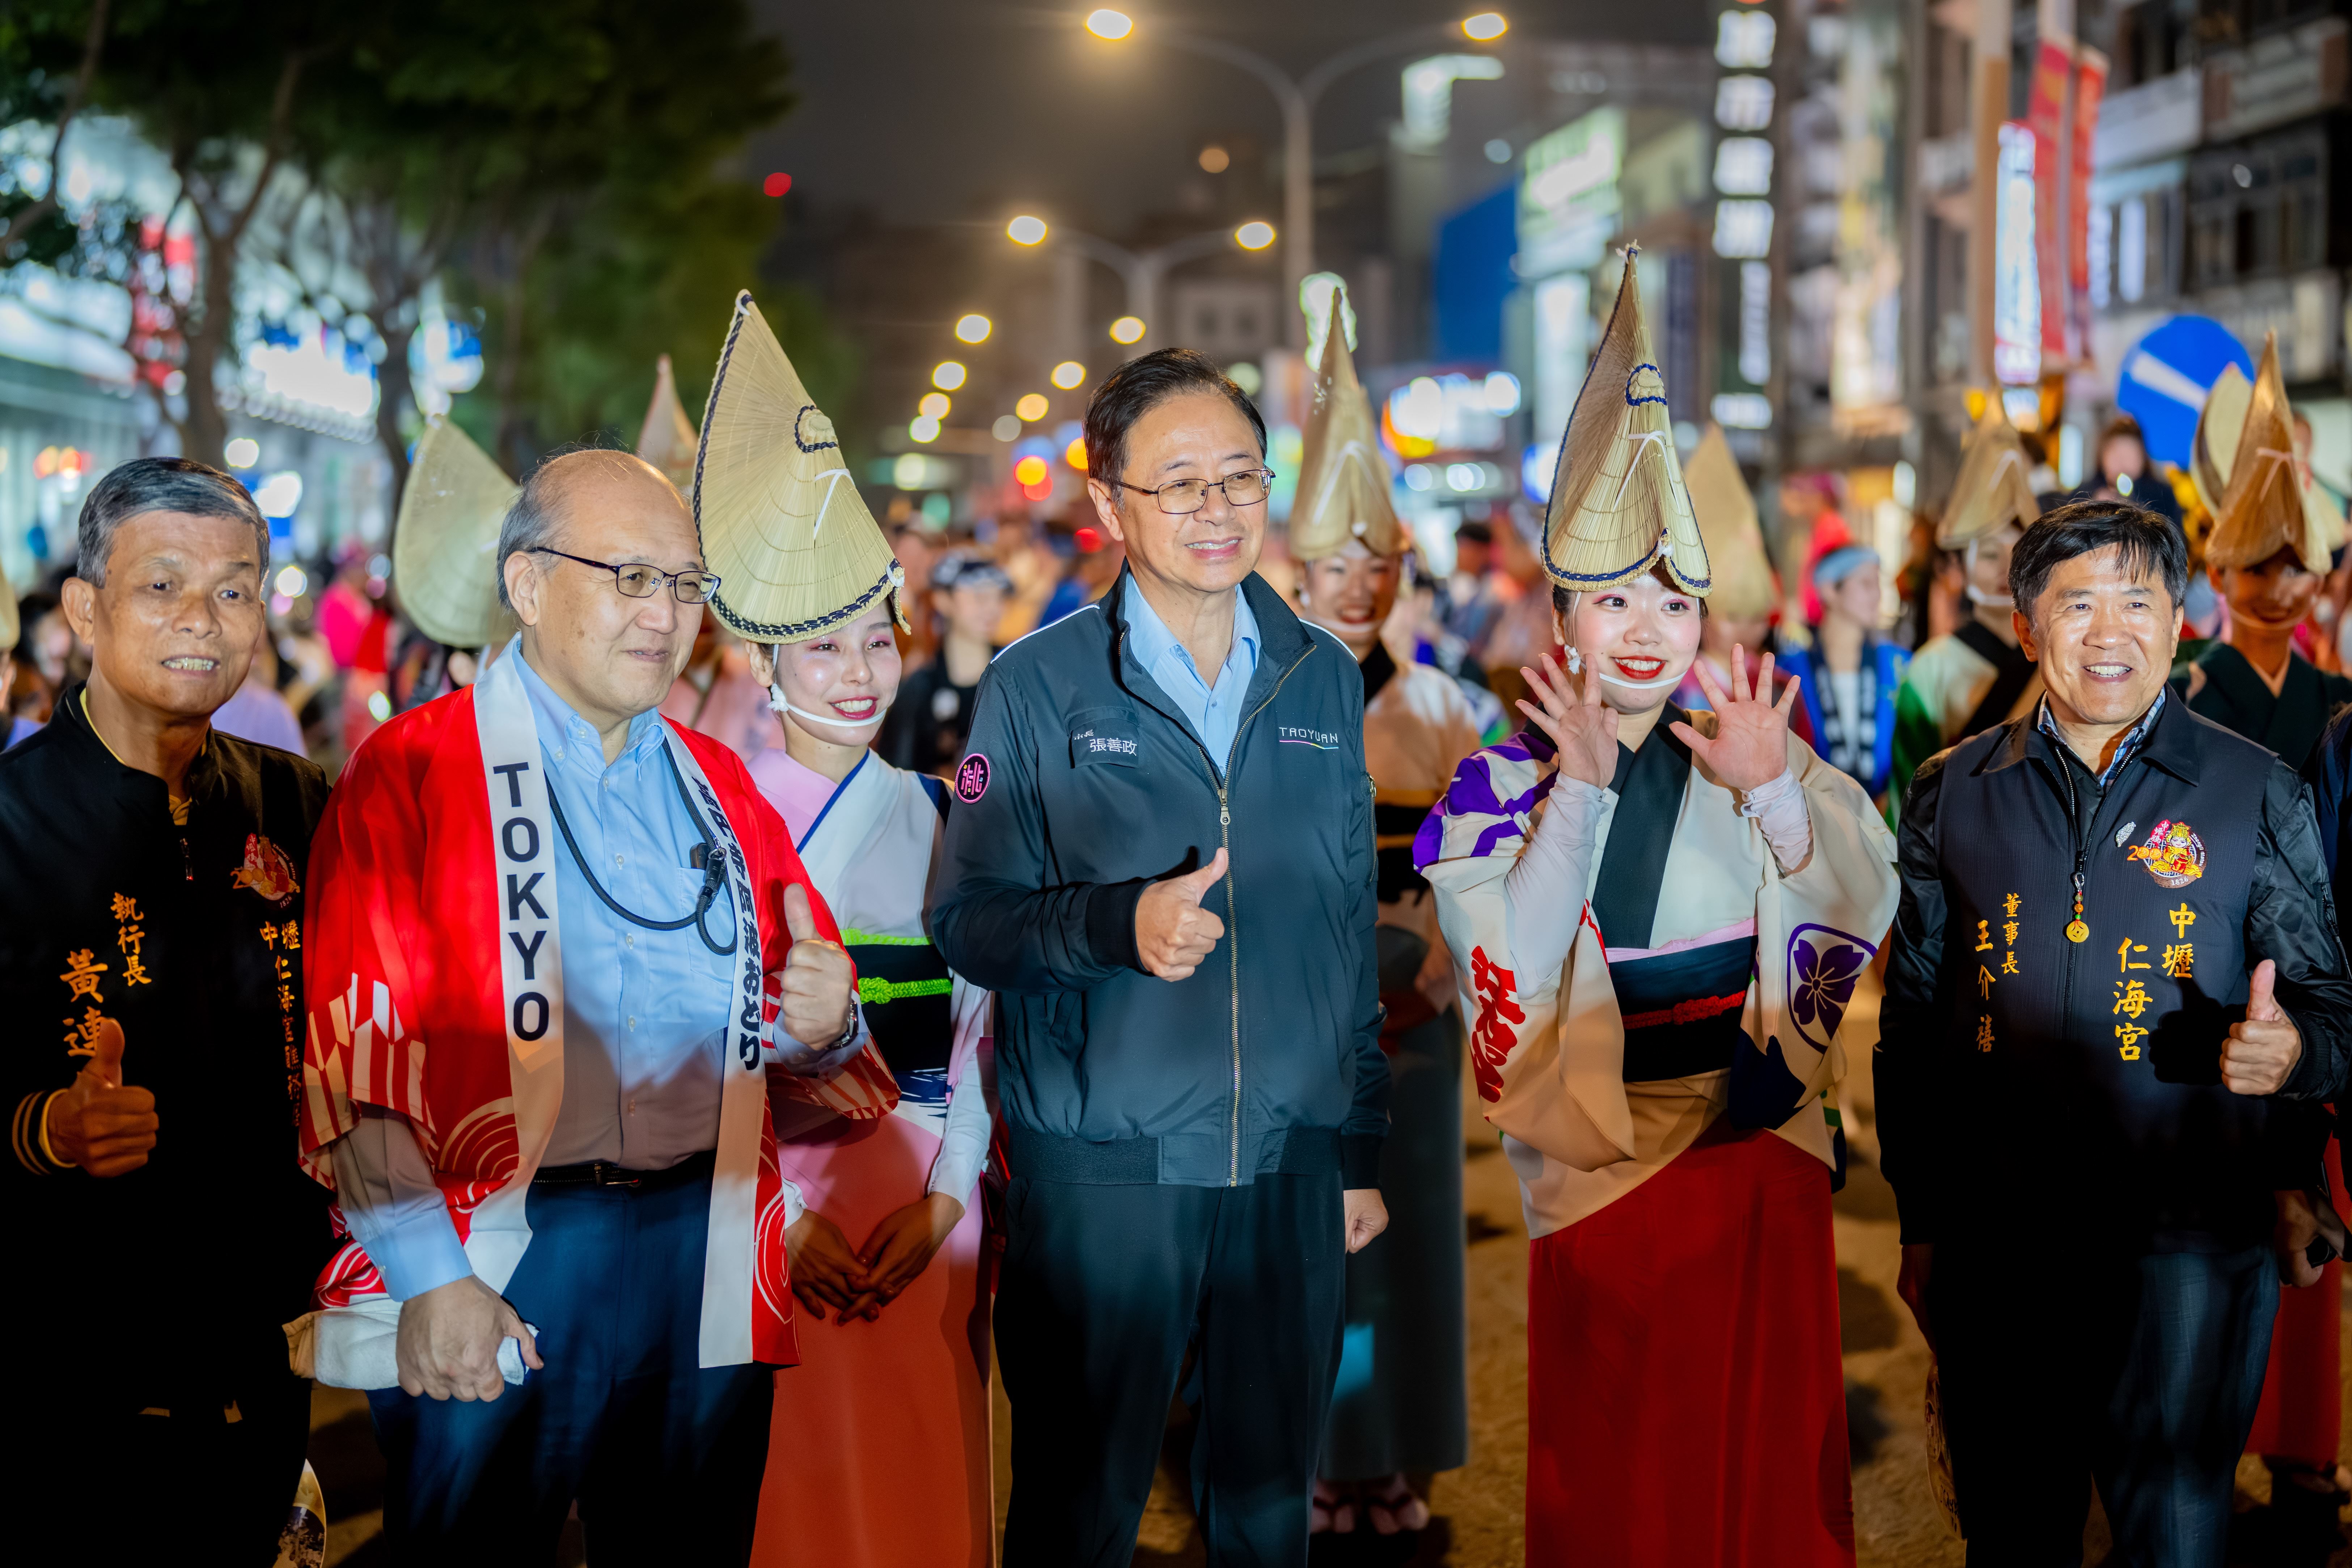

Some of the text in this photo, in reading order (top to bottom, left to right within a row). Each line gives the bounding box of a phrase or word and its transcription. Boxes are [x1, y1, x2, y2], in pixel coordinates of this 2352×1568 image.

[1073, 730, 1094, 740] 市長
[1090, 738, 1137, 756] 張善政
[1279, 727, 1338, 743] TAOYUAN
[493, 762, 549, 1042] TOKYO
[2171, 876, 2189, 886] 1826
[110, 892, 152, 987] 執行長
[2001, 893, 2022, 974] 董事長
[2161, 902, 2196, 978] 中壢
[1975, 919, 1996, 1052] 王介禧
[2112, 937, 2153, 1061] 仁海宮
